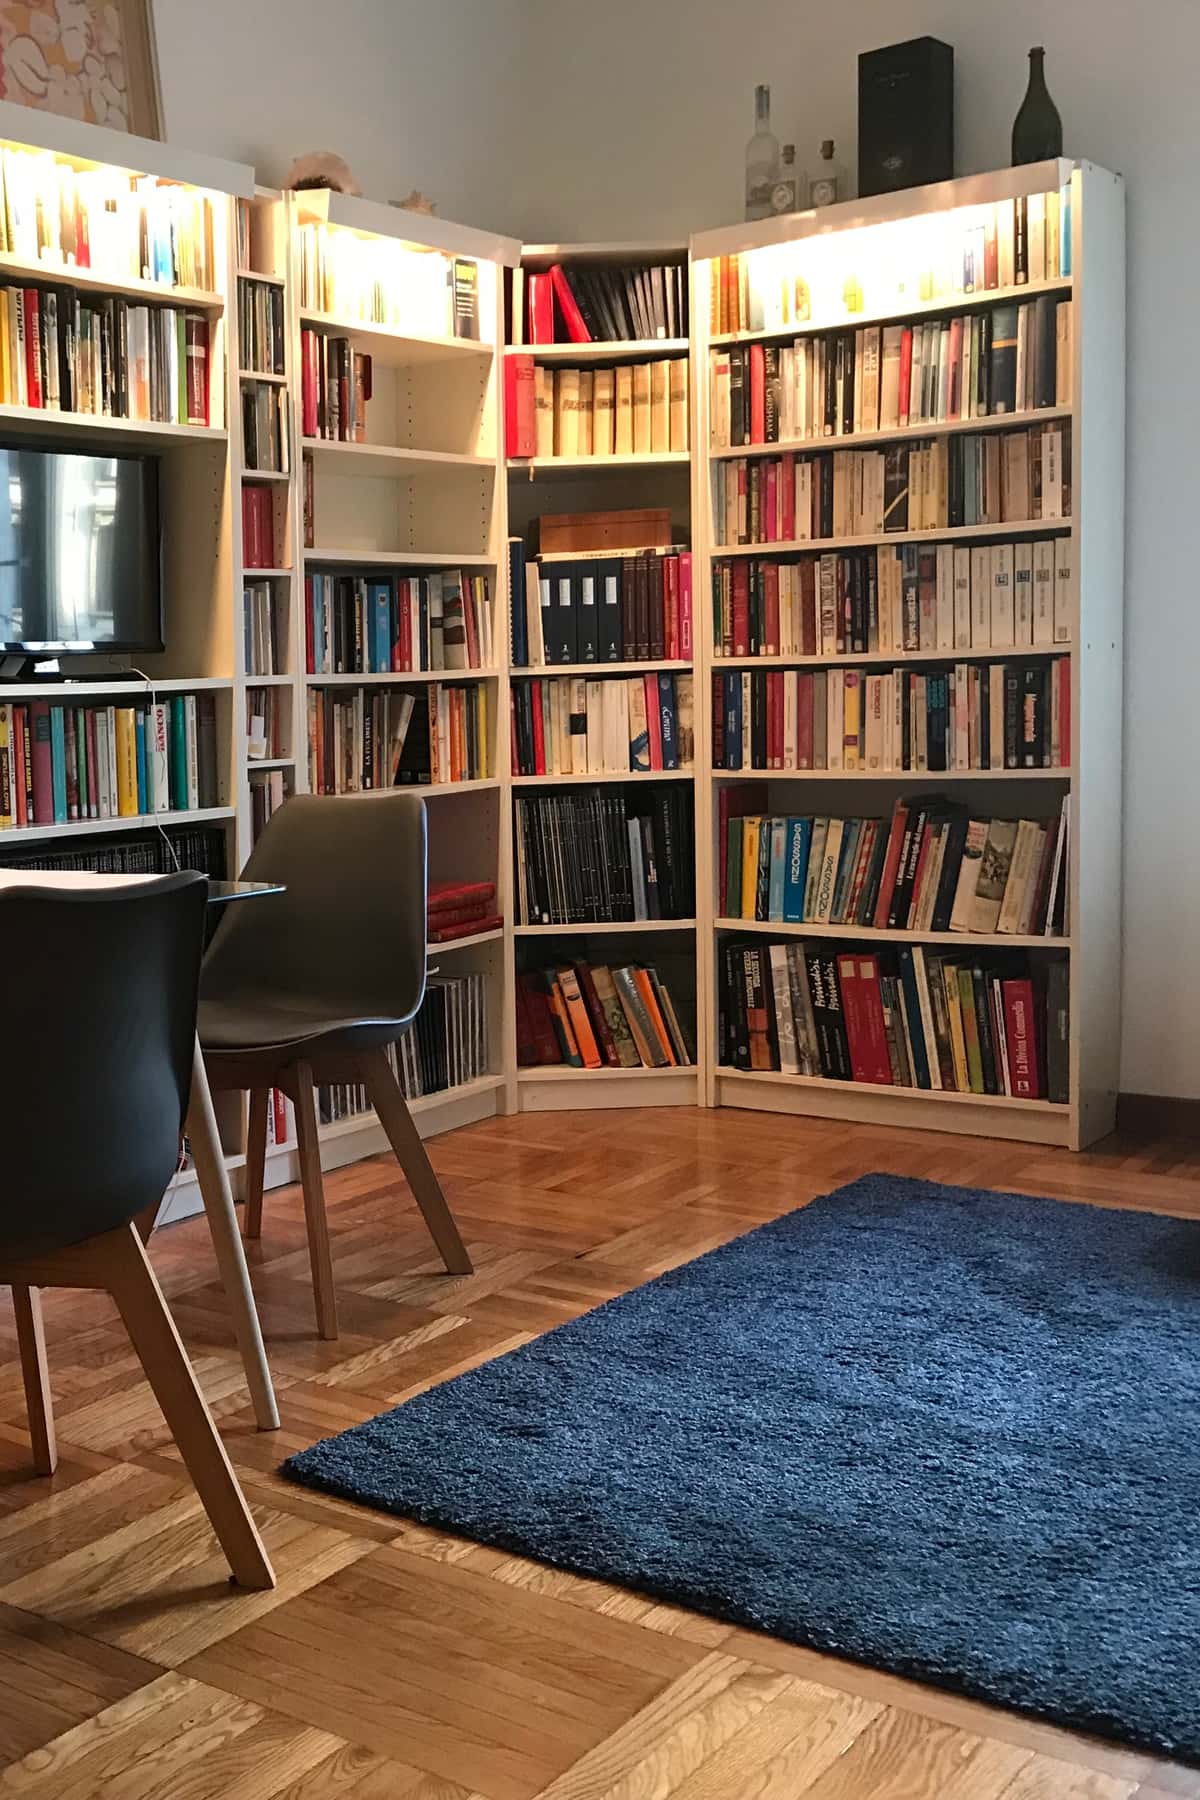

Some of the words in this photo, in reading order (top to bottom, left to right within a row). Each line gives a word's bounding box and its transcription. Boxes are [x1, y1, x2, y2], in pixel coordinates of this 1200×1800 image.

[765, 348, 775, 374] JOHN
[765, 388, 775, 433] GRISHAM
[792, 823, 802, 884] SASSONE
[818, 855, 834, 918] SASSONE
